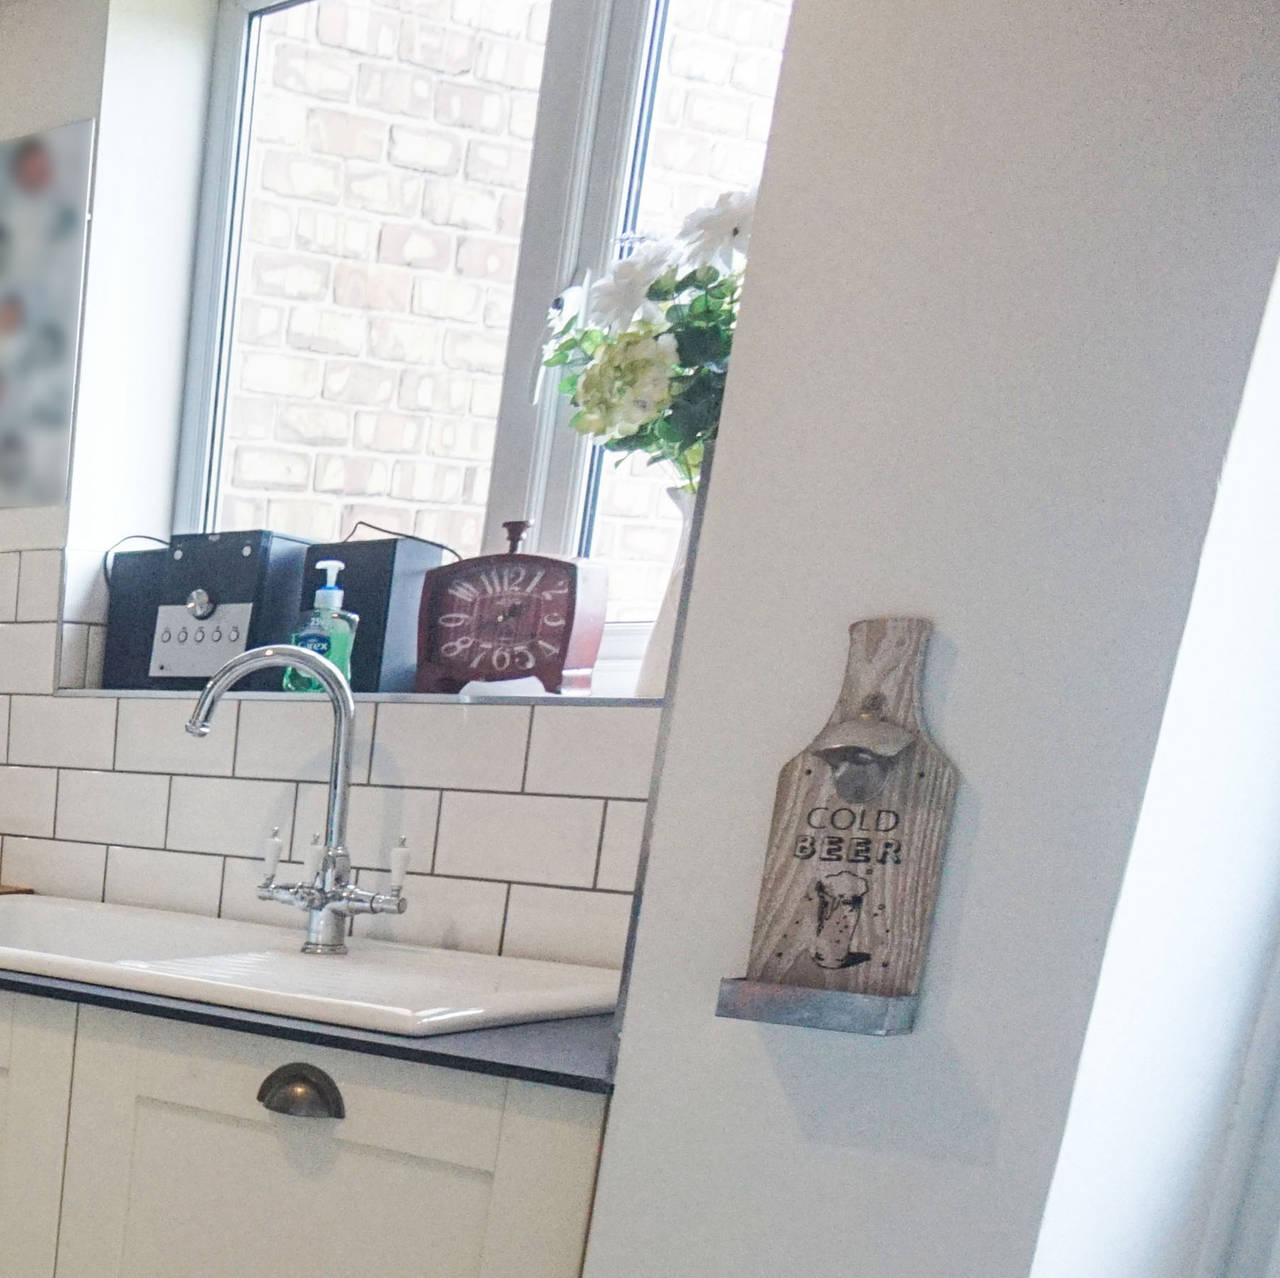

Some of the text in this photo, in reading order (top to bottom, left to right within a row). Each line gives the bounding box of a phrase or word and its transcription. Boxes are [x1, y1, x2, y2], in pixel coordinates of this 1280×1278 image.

[503, 567, 527, 592] 12
[525, 569, 546, 593] 1
[541, 580, 569, 600] 2
[440, 612, 470, 627] 9
[441, 636, 473, 657] 8
[513, 645, 536, 669] 5
[492, 647, 511, 671] 6
[807, 807, 900, 832] COLD
[794, 834, 902, 865] BEER
